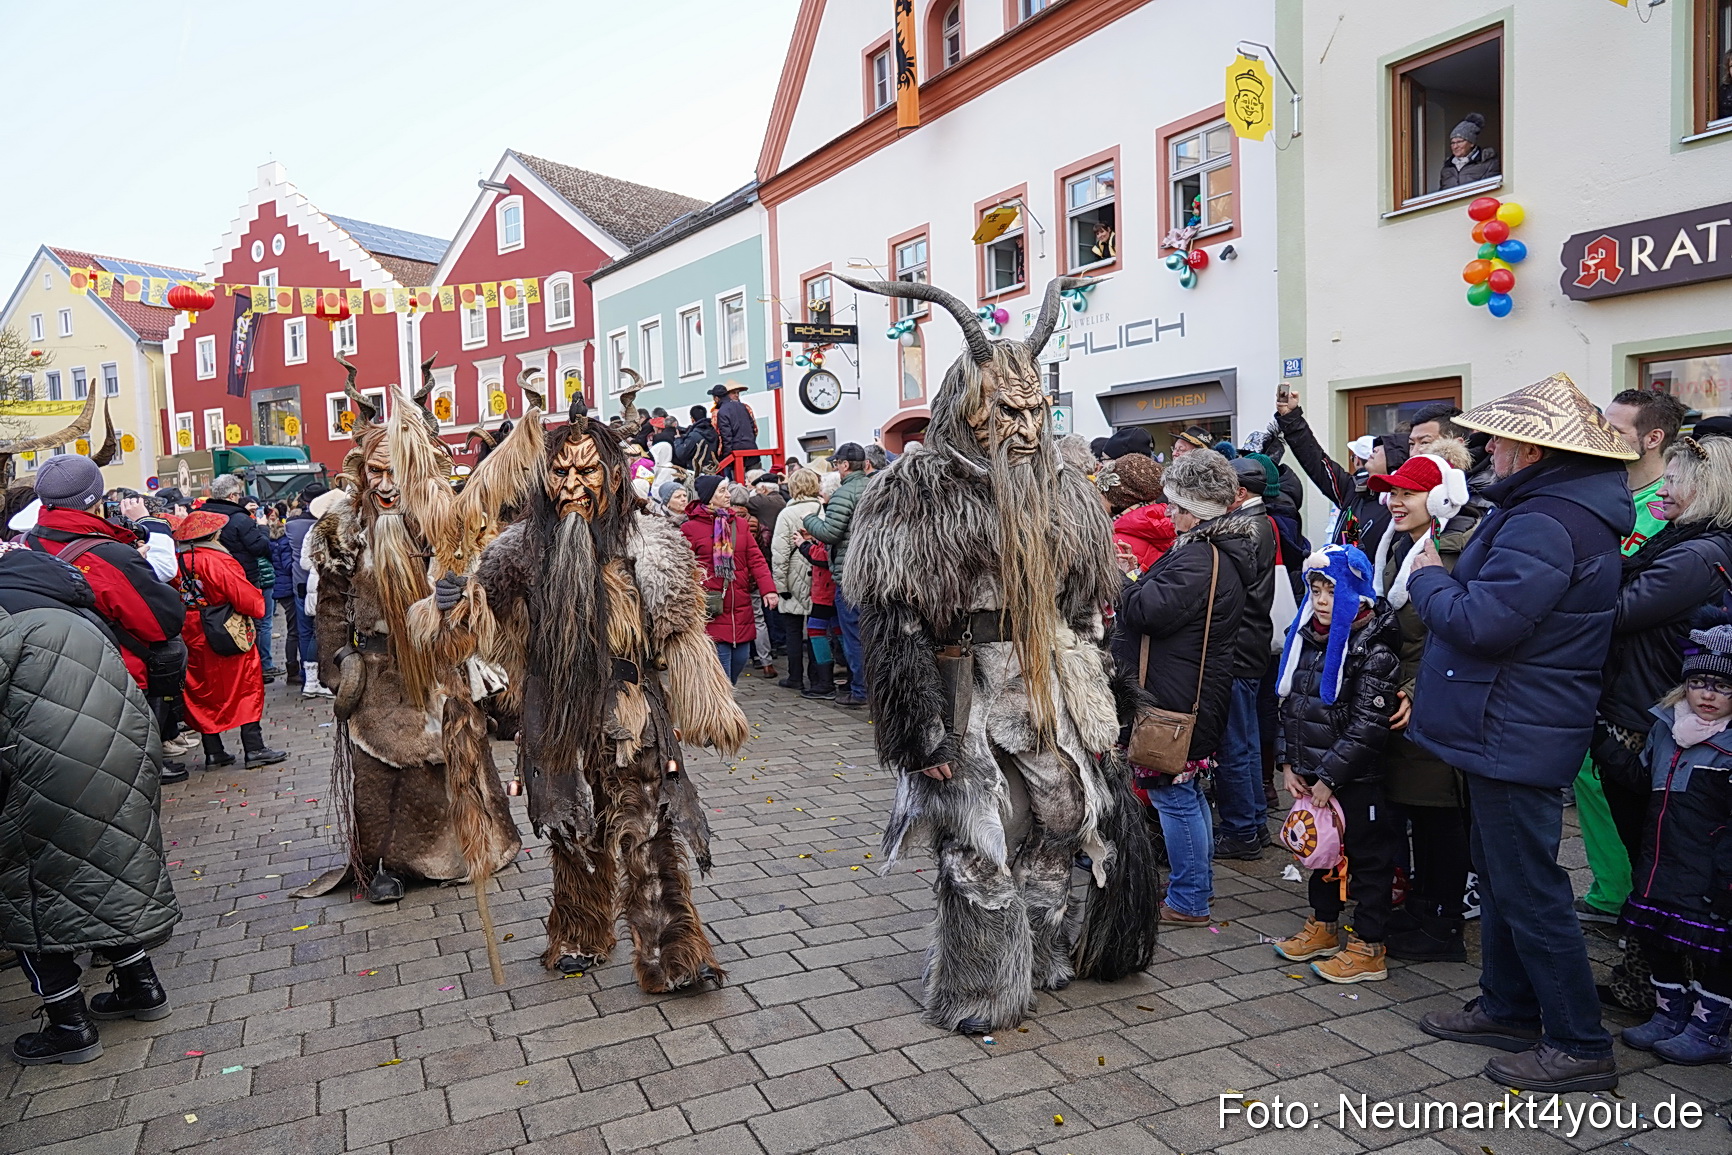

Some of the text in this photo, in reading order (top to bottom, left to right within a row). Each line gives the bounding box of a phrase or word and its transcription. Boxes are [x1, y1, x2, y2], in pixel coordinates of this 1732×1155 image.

[1630, 218, 1732, 276] RAT
[794, 325, 851, 337] RÖHLICH
[1069, 312, 1185, 356] HLICH
[1286, 359, 1300, 371] 20
[1651, 375, 1732, 396] Sonde
[1152, 392, 1207, 409] UHREN
